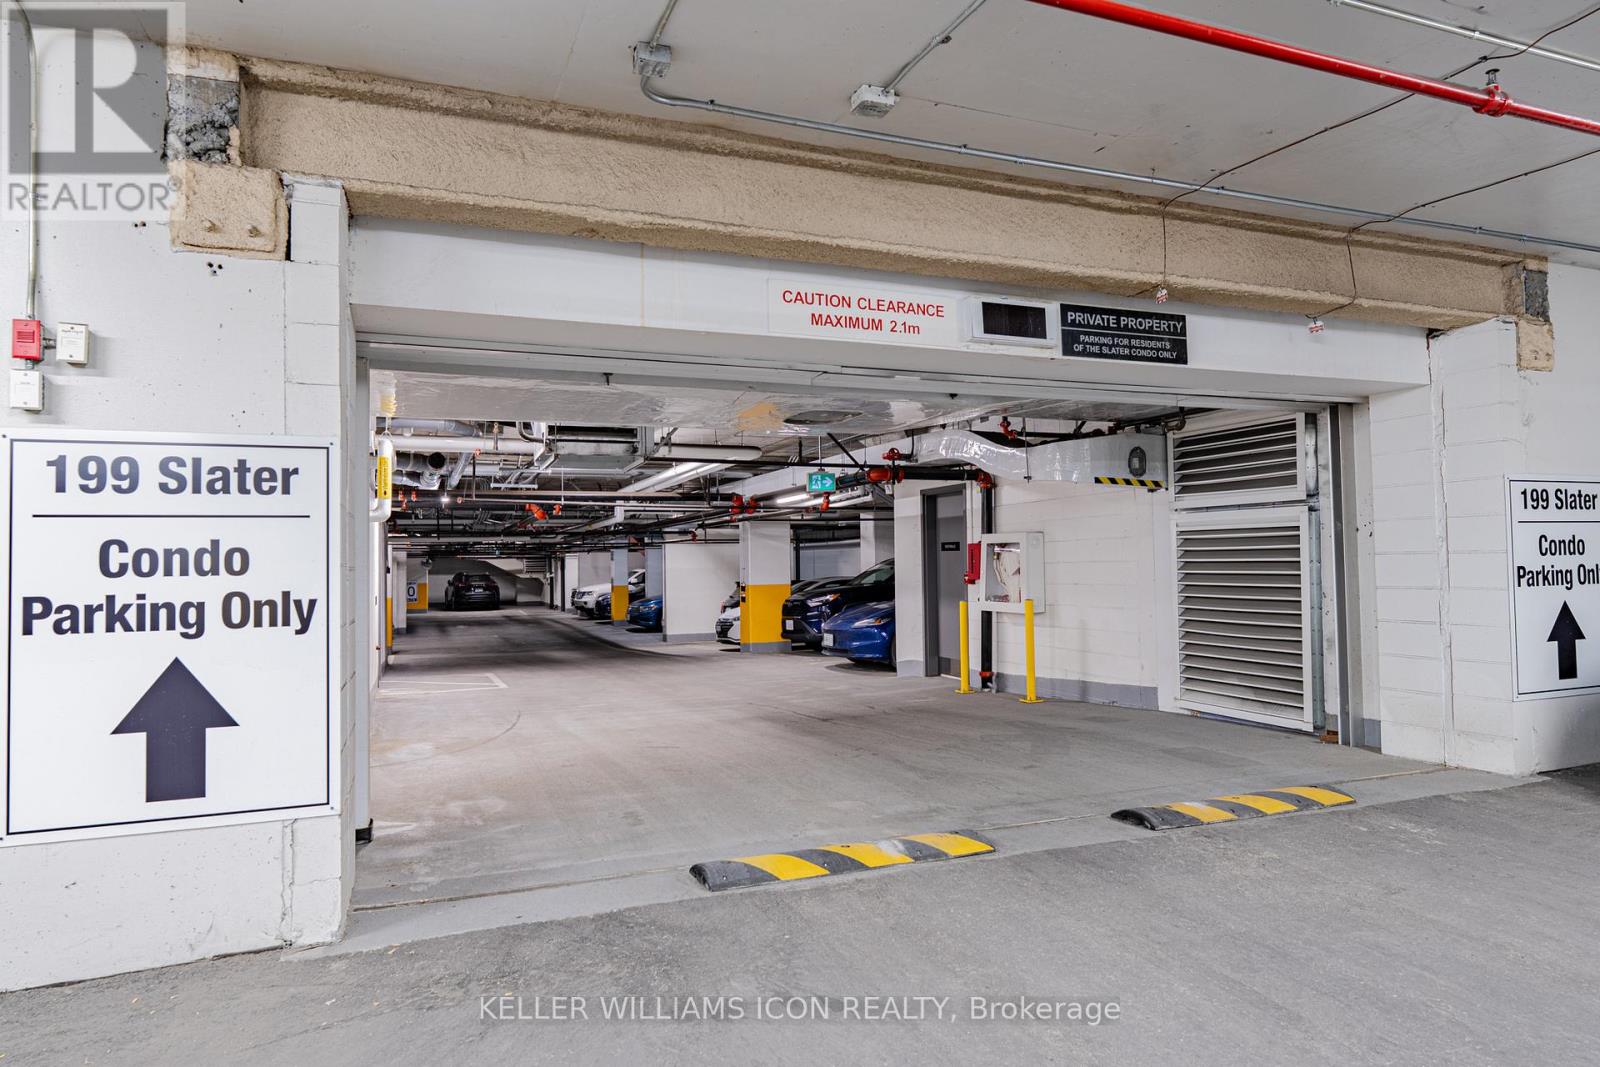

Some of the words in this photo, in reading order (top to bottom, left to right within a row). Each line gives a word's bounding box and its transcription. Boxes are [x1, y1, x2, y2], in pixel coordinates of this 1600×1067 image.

[782, 290, 851, 308] CAUTION
[857, 297, 945, 318] CLEARANCE
[810, 313, 883, 331] MAXIMUM
[889, 320, 921, 334] 2.1m
[1067, 311, 1118, 328] PRIVATE
[1120, 316, 1184, 333] PROPERTY
[1073, 343, 1084, 352] OF
[1085, 344, 1101, 353] THE
[1101, 345, 1131, 355] SLATER
[1131, 348, 1158, 358] CONDO
[1158, 350, 1178, 359] ONLY
[1080, 334, 1113, 345] PARKING
[1114, 338, 1130, 347] FOR
[1130, 339, 1171, 350] RESIDENTS
[46, 455, 139, 495] 199
[158, 456, 300, 496] Slater
[1520, 488, 1550, 511] 199
[1554, 488, 1598, 511] Slater
[1538, 534, 1586, 557] Condo
[99, 538, 250, 579] Condo
[1516, 564, 1574, 591] Parking
[1577, 563, 1600, 585] Onl
[21, 593, 206, 640] Parking
[221, 590, 318, 636] Only
